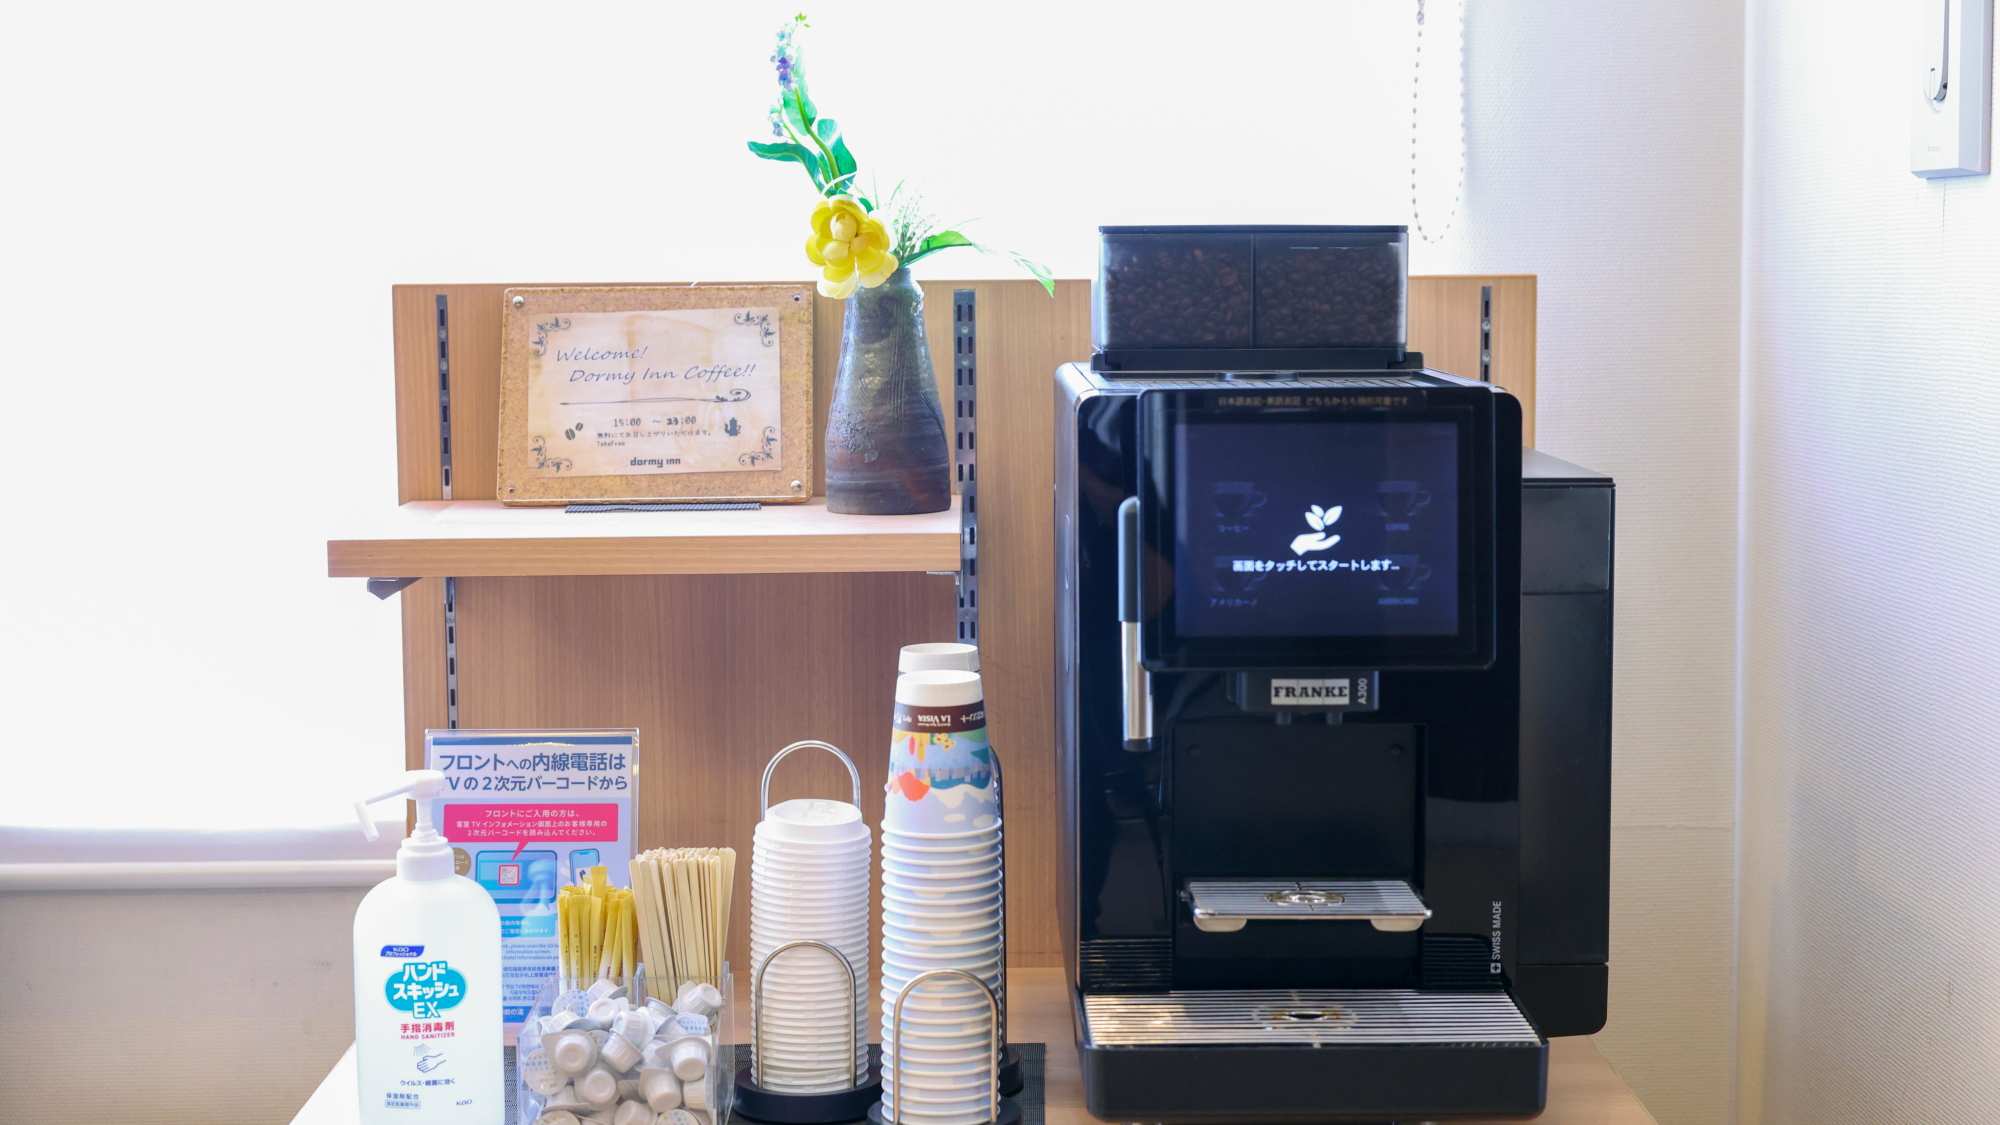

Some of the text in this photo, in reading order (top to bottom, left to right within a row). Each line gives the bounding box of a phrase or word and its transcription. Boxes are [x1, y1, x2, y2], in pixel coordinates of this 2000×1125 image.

[556, 346, 648, 362] Welcome!
[569, 363, 756, 385] Dormy Inn Coffee!!
[613, 418, 642, 427] 15:00
[666, 416, 697, 426] 23:00
[630, 457, 663, 468] dormy
[1273, 686, 1348, 698] FRANKE
[1357, 678, 1368, 704] A300
[917, 715, 940, 724] VISTA
[940, 715, 951, 723] LA
[439, 752, 626, 772] フロントへの内線電話は
[485, 809, 579, 818] フロントにご入用の方は、
[467, 828, 597, 837] 2次元バーコードを読み込んでください。
[1492, 901, 1502, 960] SWISS MADE
[402, 962, 446, 982] ハンド
[393, 981, 460, 1000] スキッシュ
[413, 1001, 441, 1018] EX
[400, 1021, 455, 1034] 手指消毒剤
[386, 1092, 419, 1100] 保湿剤配合
